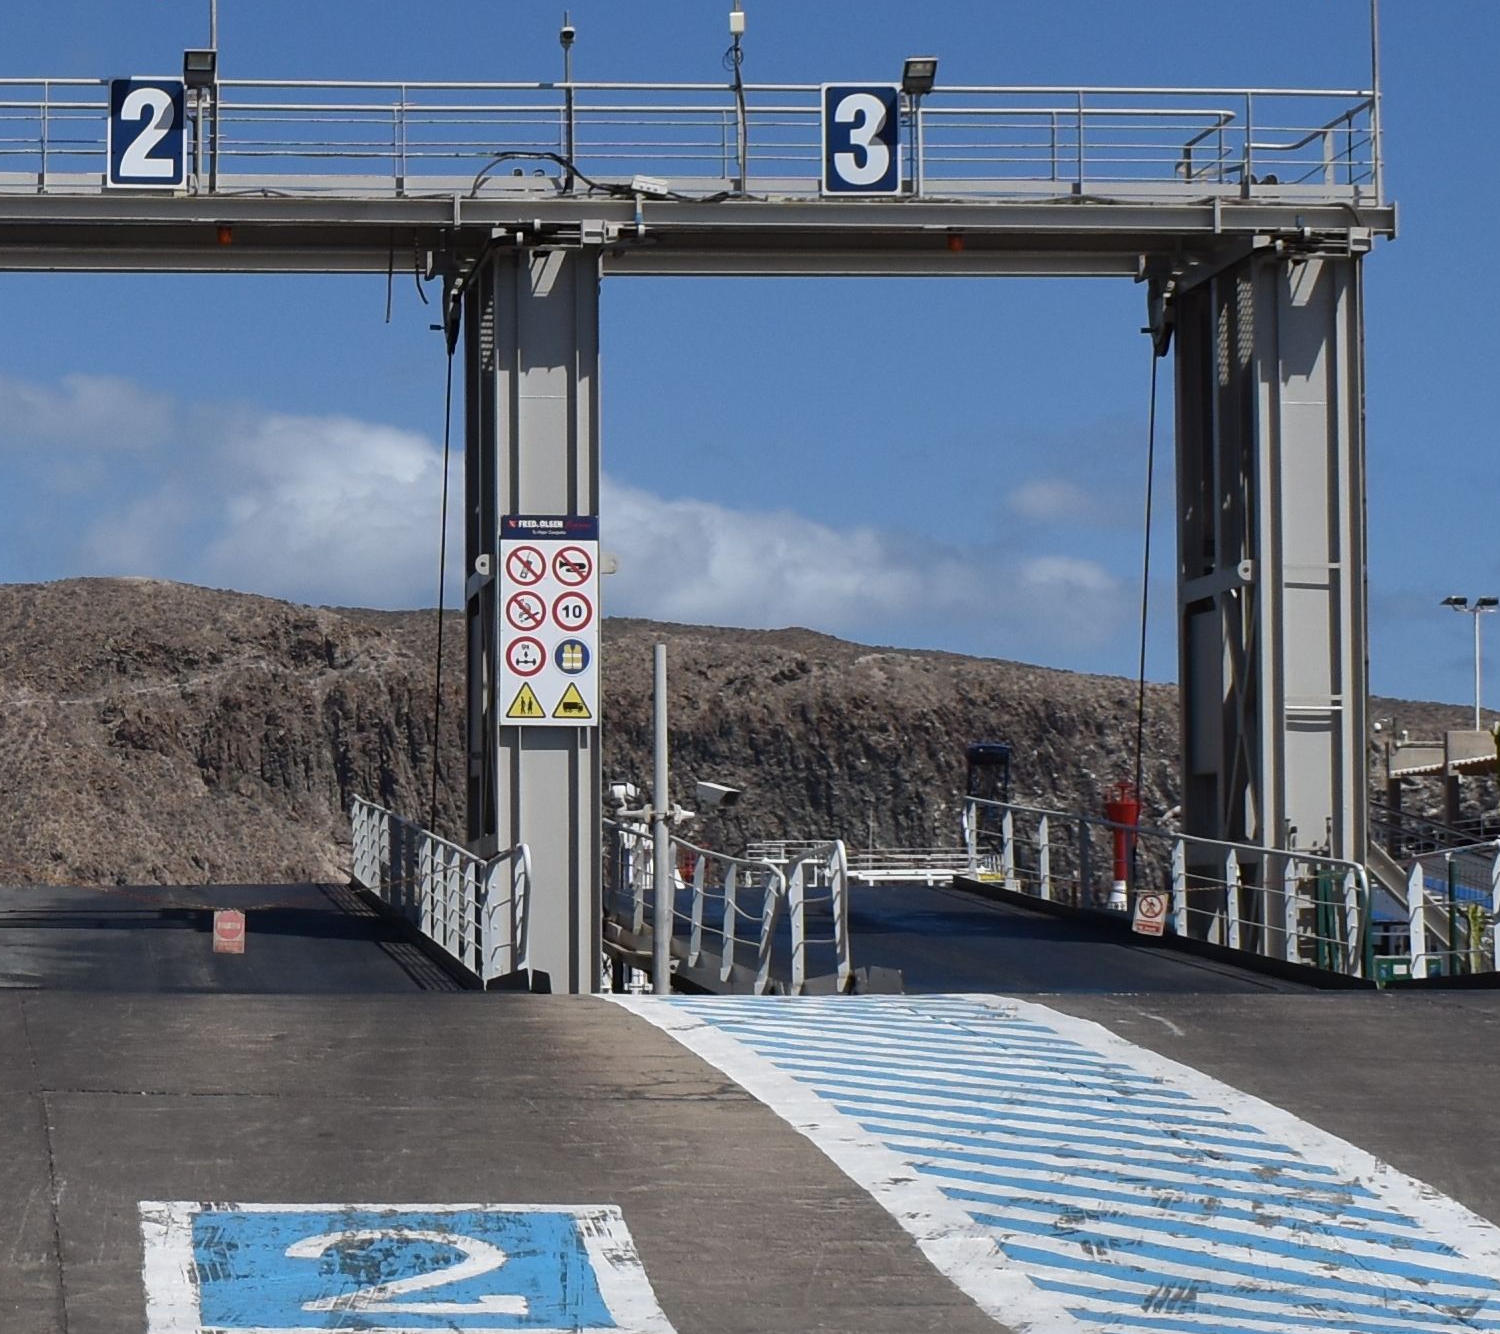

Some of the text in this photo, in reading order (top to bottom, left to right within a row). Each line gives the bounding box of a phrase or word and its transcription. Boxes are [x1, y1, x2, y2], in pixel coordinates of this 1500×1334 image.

[119, 87, 175, 178] 2
[833, 92, 890, 186] 3
[562, 604, 583, 619] 10
[284, 1228, 529, 1315] 2
